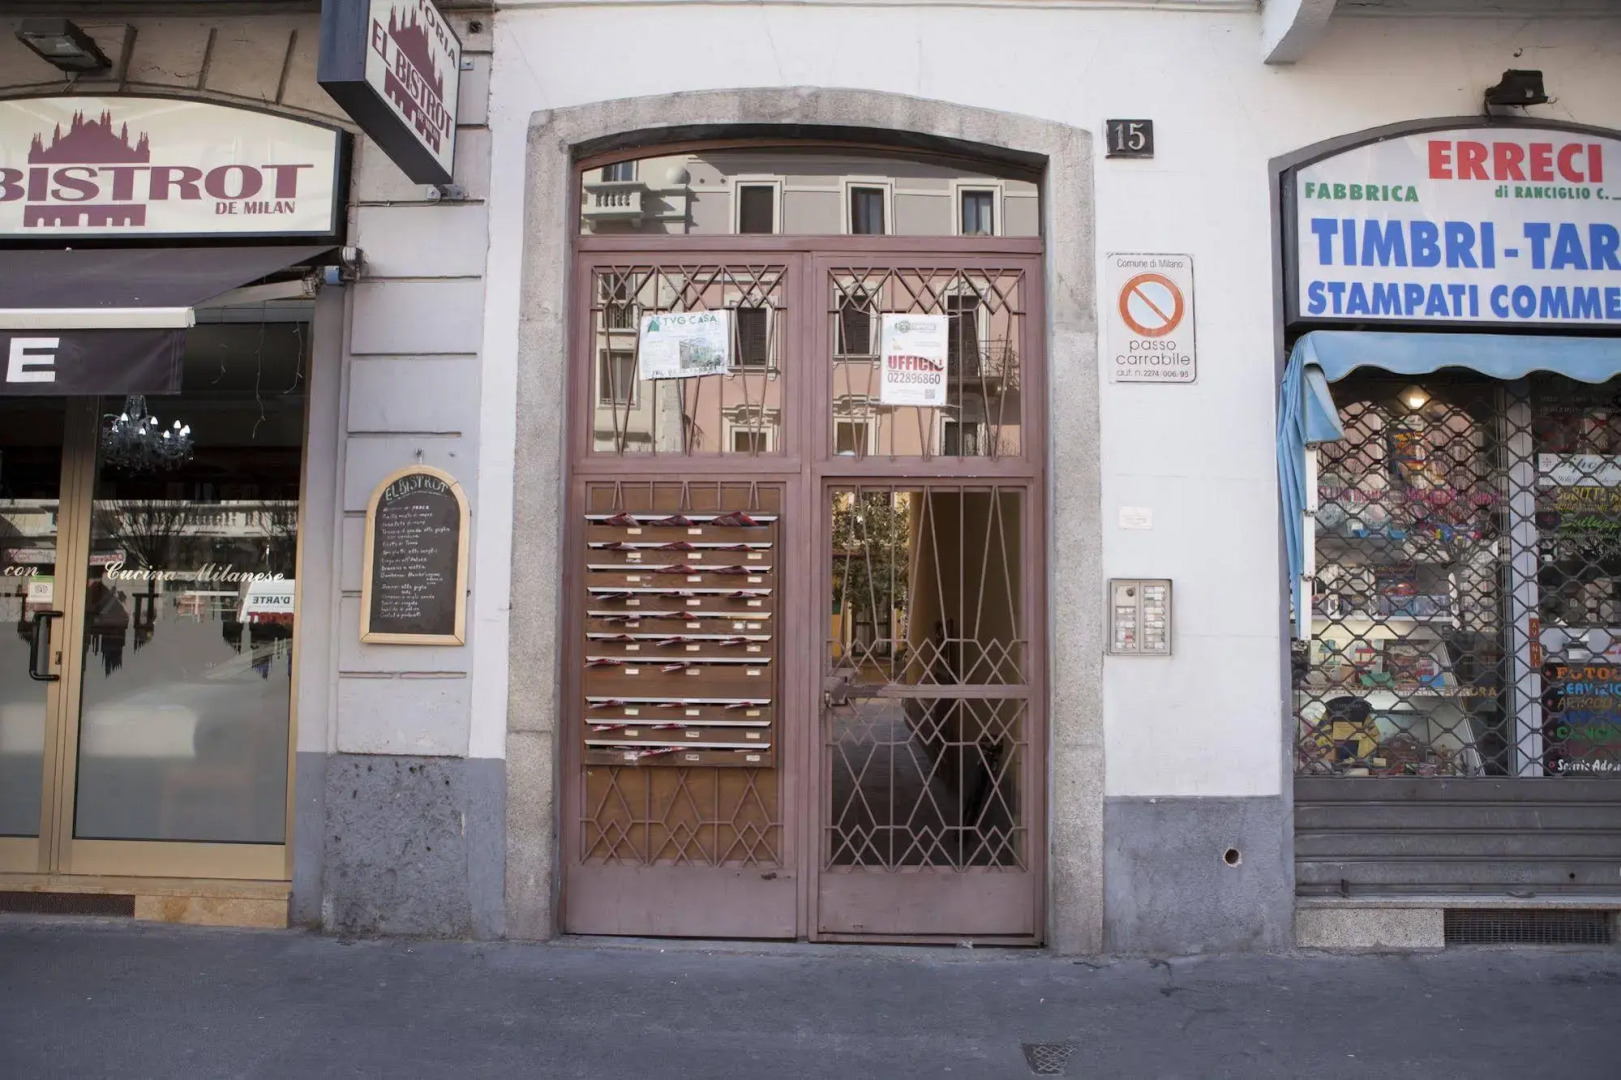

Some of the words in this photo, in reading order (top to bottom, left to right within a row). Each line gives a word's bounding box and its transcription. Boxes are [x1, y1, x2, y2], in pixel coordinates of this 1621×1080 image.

[372, 17, 391, 67] EL
[396, 47, 453, 139] BISTROT
[1115, 123, 1146, 151] 15
[1428, 140, 1603, 183] ERRECI
[1304, 182, 1419, 203] FABBRICA
[1494, 185, 1509, 199] di
[1514, 186, 1591, 200] RANCIGLIO
[215, 202, 238, 215] DE
[243, 201, 296, 215] MILAN
[1117, 258, 1148, 268] Comune
[1150, 259, 1157, 268] di
[1159, 259, 1183, 268] Milano
[1307, 280, 1479, 318] STAMPATI
[1490, 284, 1621, 320] COMME
[662, 316, 686, 326] TVG
[689, 314, 718, 325] CASA
[1129, 340, 1177, 353] passo
[6, 337, 60, 383] E
[1115, 353, 1191, 366] carrabile
[887, 372, 941, 384] 022896860
[4, 566, 38, 576] con
[104, 561, 176, 582] Cucina
[194, 563, 284, 583] Milanese
[1530, 621, 1540, 667] AVNTI
